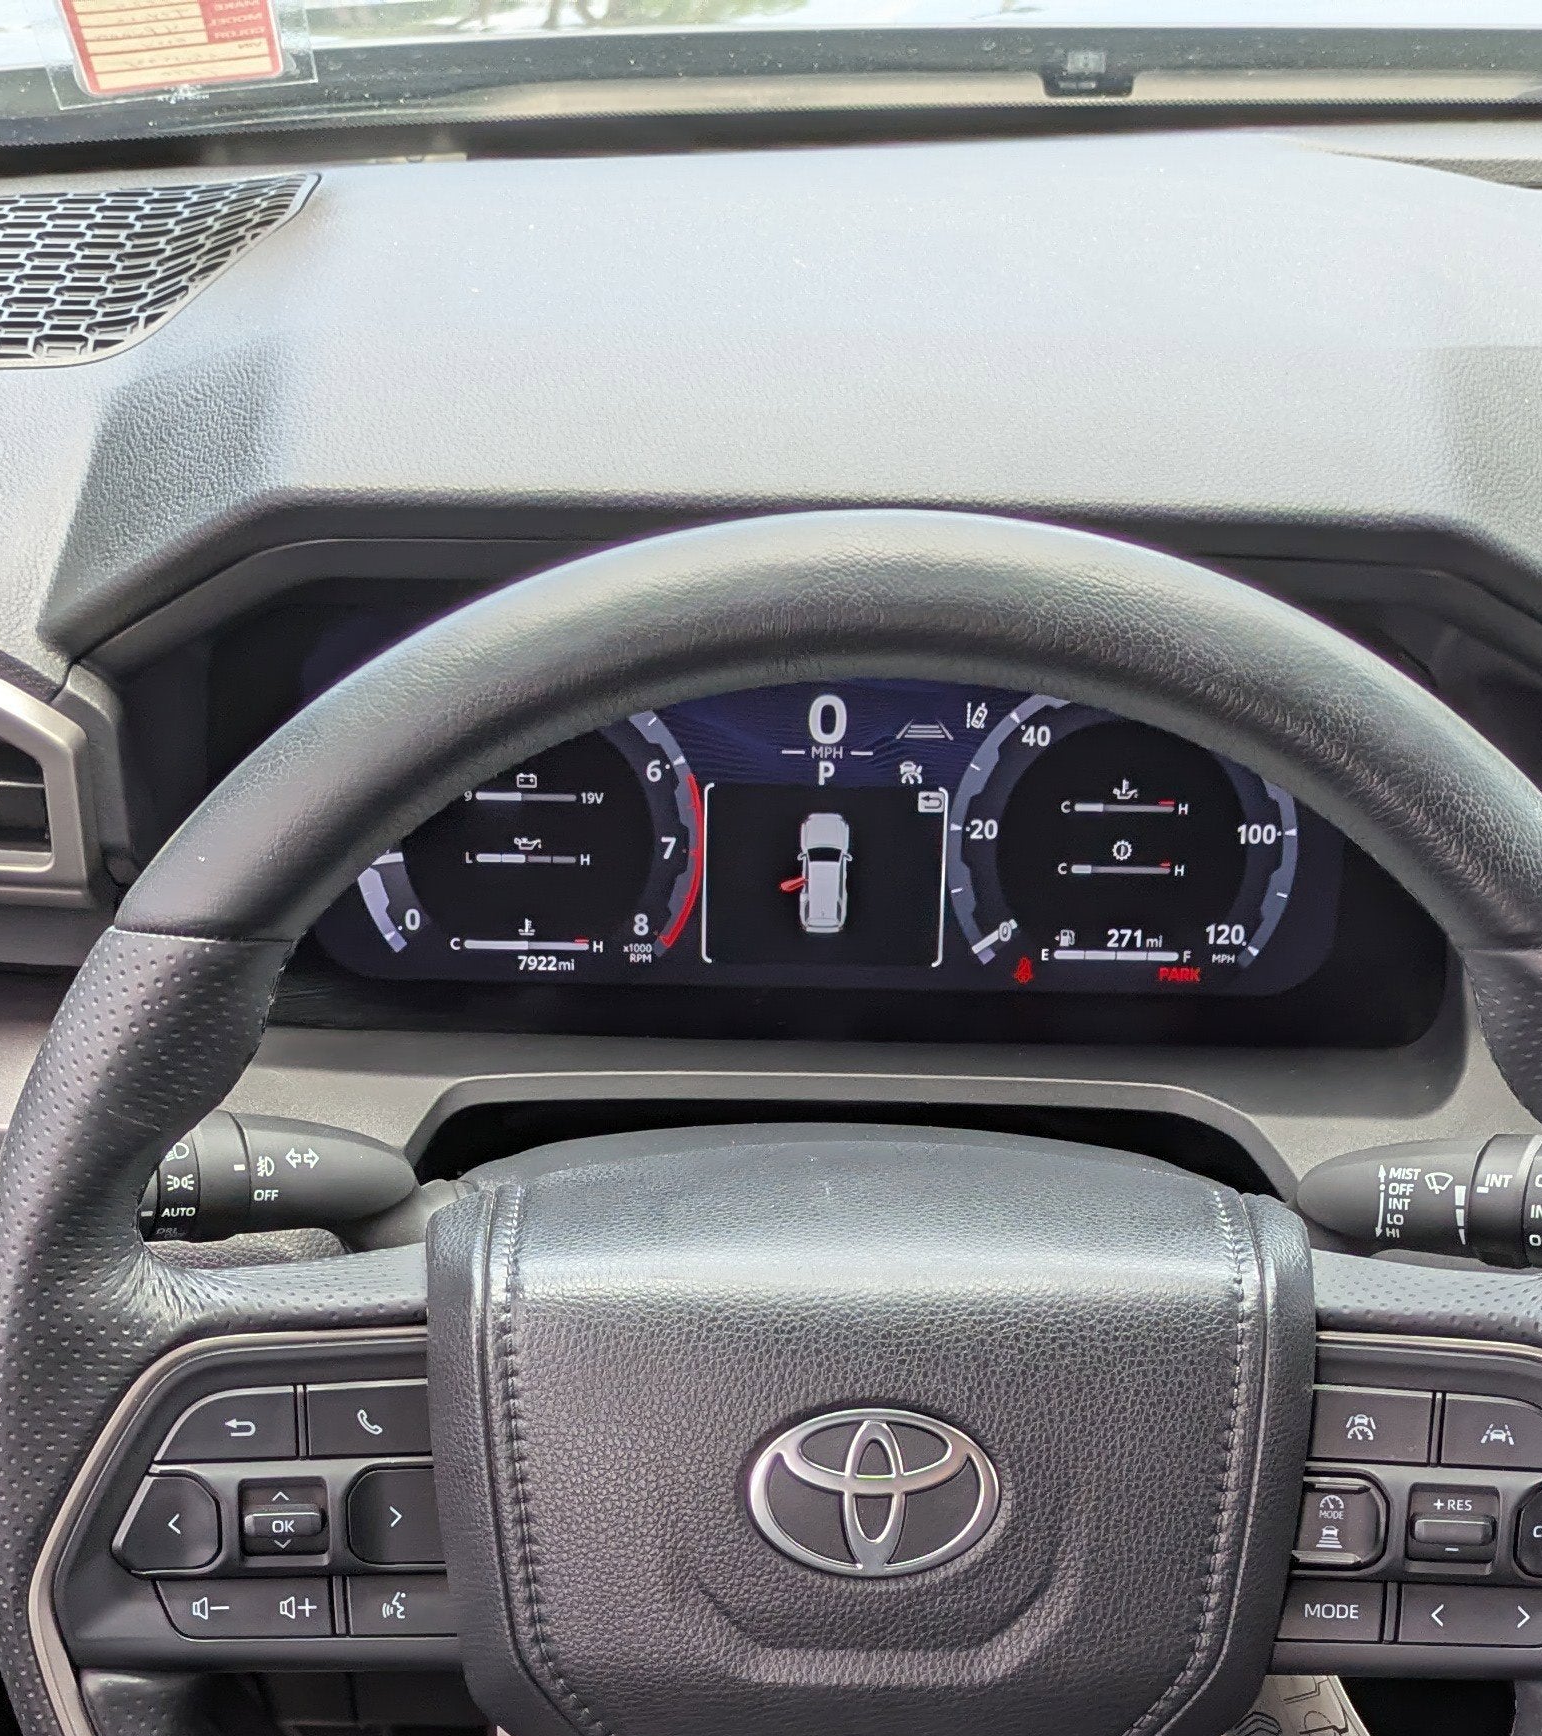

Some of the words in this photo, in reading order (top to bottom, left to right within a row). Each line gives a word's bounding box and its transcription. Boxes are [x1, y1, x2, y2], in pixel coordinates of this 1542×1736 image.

[809, 694, 847, 745] 0
[1021, 725, 1052, 748] 40
[810, 746, 845, 760] MPH
[646, 760, 662, 782] 6
[818, 762, 836, 786] P
[463, 789, 473, 803] 9
[581, 790, 605, 805] 19V
[1060, 800, 1071, 814] C
[1177, 801, 1189, 816] H
[970, 818, 999, 841] 20
[1236, 823, 1277, 846] 100
[660, 837, 677, 860] 7
[464, 852, 474, 865] L
[580, 854, 591, 867] H
[1057, 862, 1068, 876] C
[1174, 863, 1185, 877] H
[404, 908, 421, 931] 0
[633, 914, 649, 936] 8
[1106, 929, 1143, 949] 271
[1145, 933, 1163, 949] mi
[1205, 924, 1245, 946] 120
[449, 937, 461, 952] C
[593, 940, 604, 954] H
[623, 943, 653, 954] x1000
[517, 955, 557, 972] 7922
[558, 957, 575, 972] mi
[629, 953, 653, 964] RPM
[1041, 948, 1049, 962] E
[1182, 950, 1192, 964] F
[1212, 953, 1236, 965] MPH
[1159, 968, 1200, 983] PARK
[1388, 1167, 1422, 1181] MIST
[1484, 1173, 1513, 1188] INT
[253, 1189, 279, 1202] OFF
[1388, 1182, 1415, 1196] OFF
[160, 1206, 196, 1218] AUTO
[1388, 1198, 1411, 1211] INT
[1386, 1213, 1404, 1226] LO
[1385, 1227, 1400, 1238] HI
[1318, 1510, 1345, 1520] MODE
[271, 1519, 295, 1534] OK
[1303, 1603, 1360, 1620] MODE
